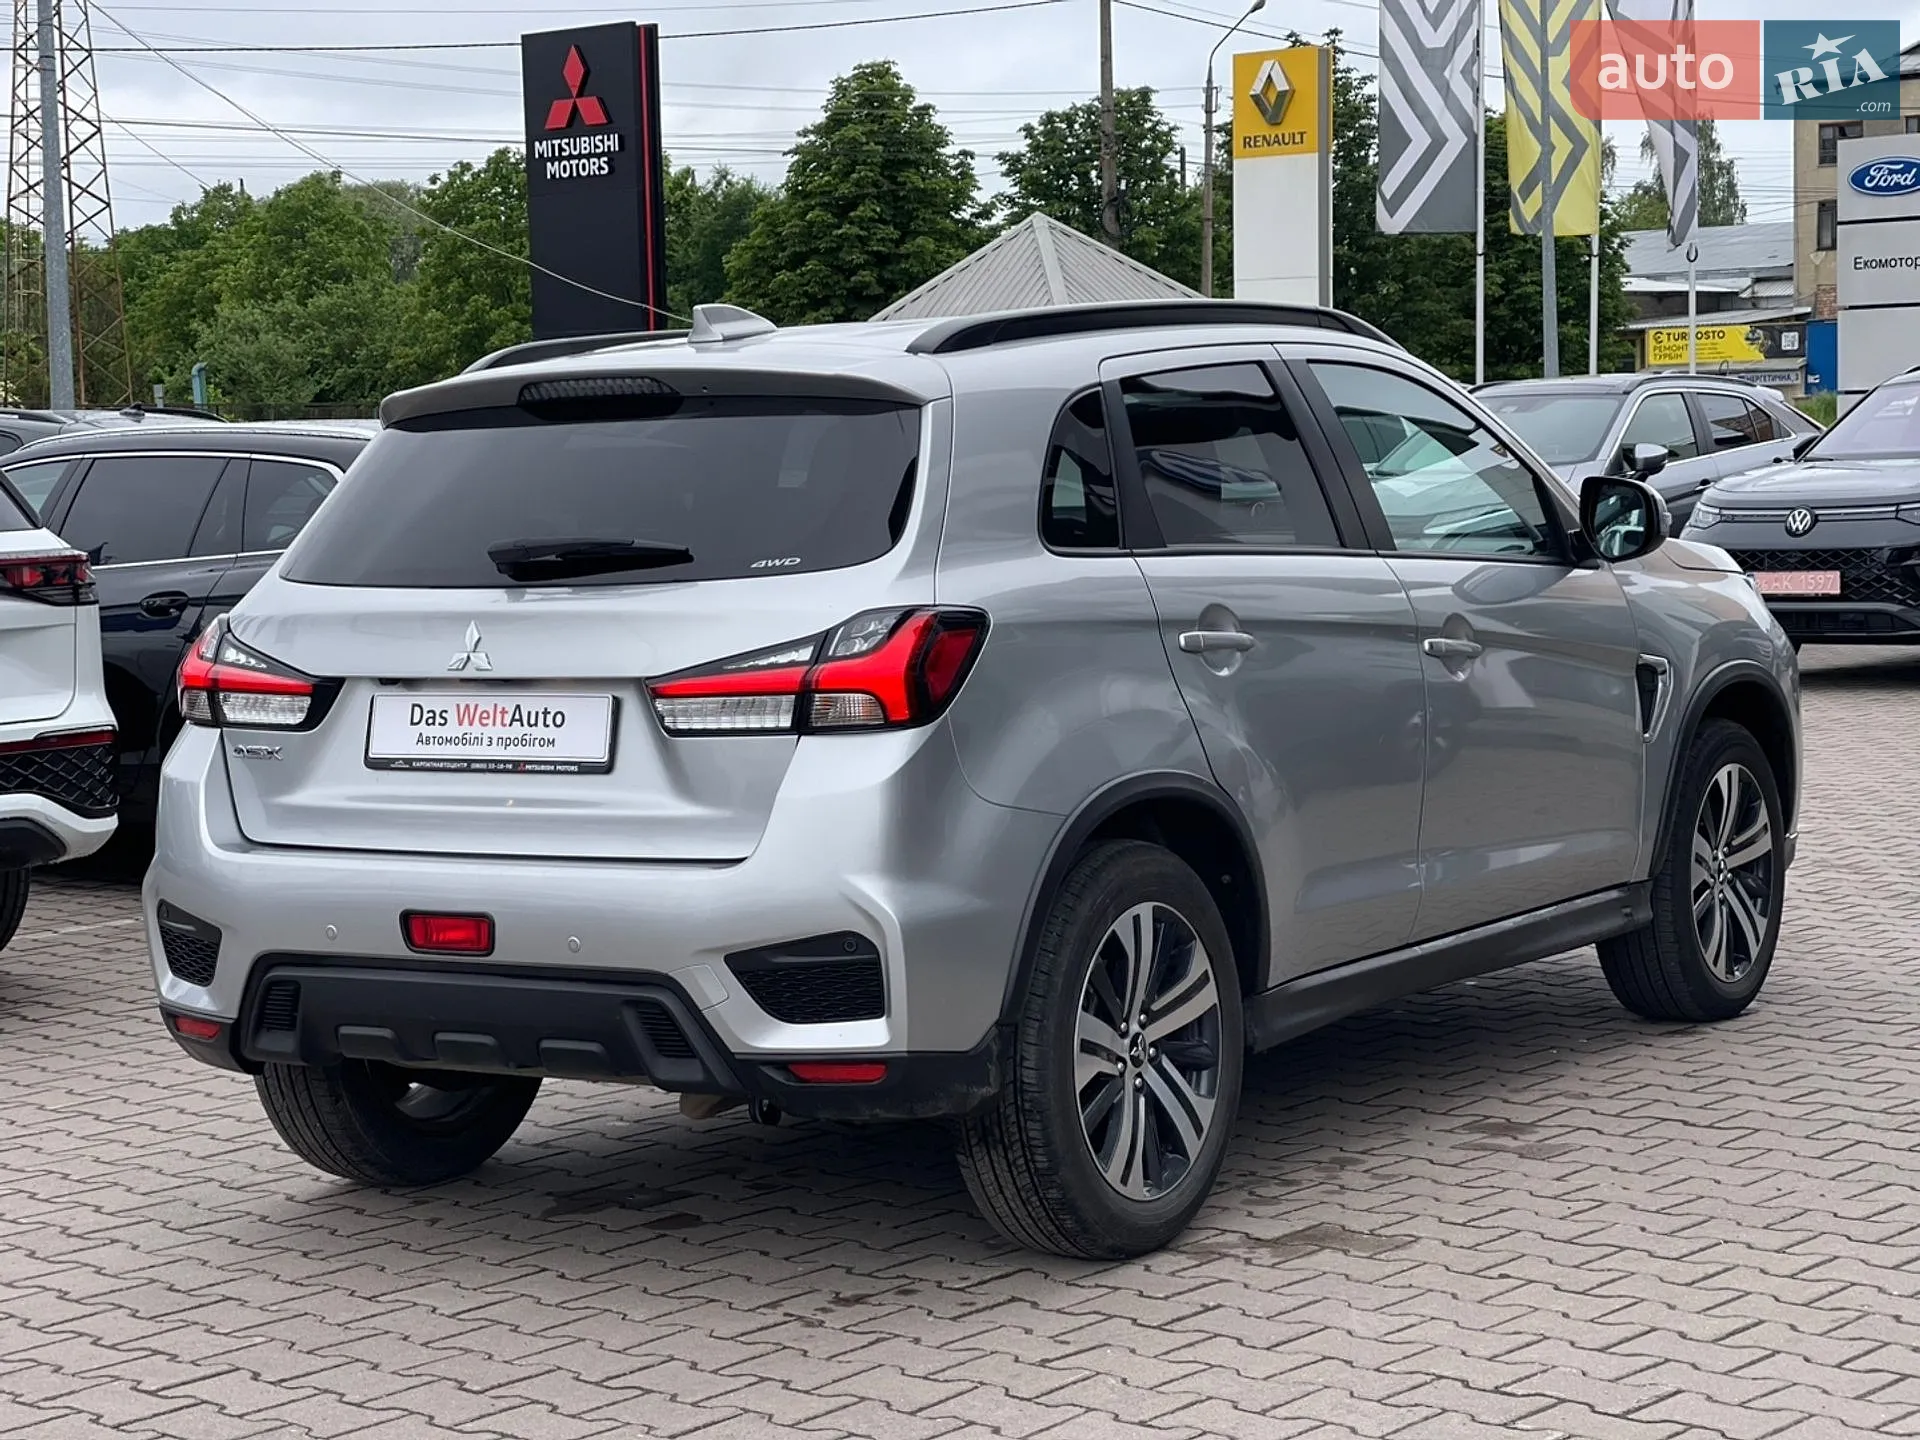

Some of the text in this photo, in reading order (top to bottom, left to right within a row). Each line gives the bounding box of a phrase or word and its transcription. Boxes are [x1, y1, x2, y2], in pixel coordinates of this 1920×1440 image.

[534, 133, 619, 159] MITSUBISHI
[1242, 130, 1308, 149] RENAULT
[546, 156, 609, 180] MOTORS
[1863, 163, 1918, 188] Ford
[1666, 329, 1726, 342] TUROSTO
[750, 557, 801, 568] 4WD
[410, 703, 566, 728] Das WeltAuto
[416, 732, 556, 749] Автомобілі з пробігом
